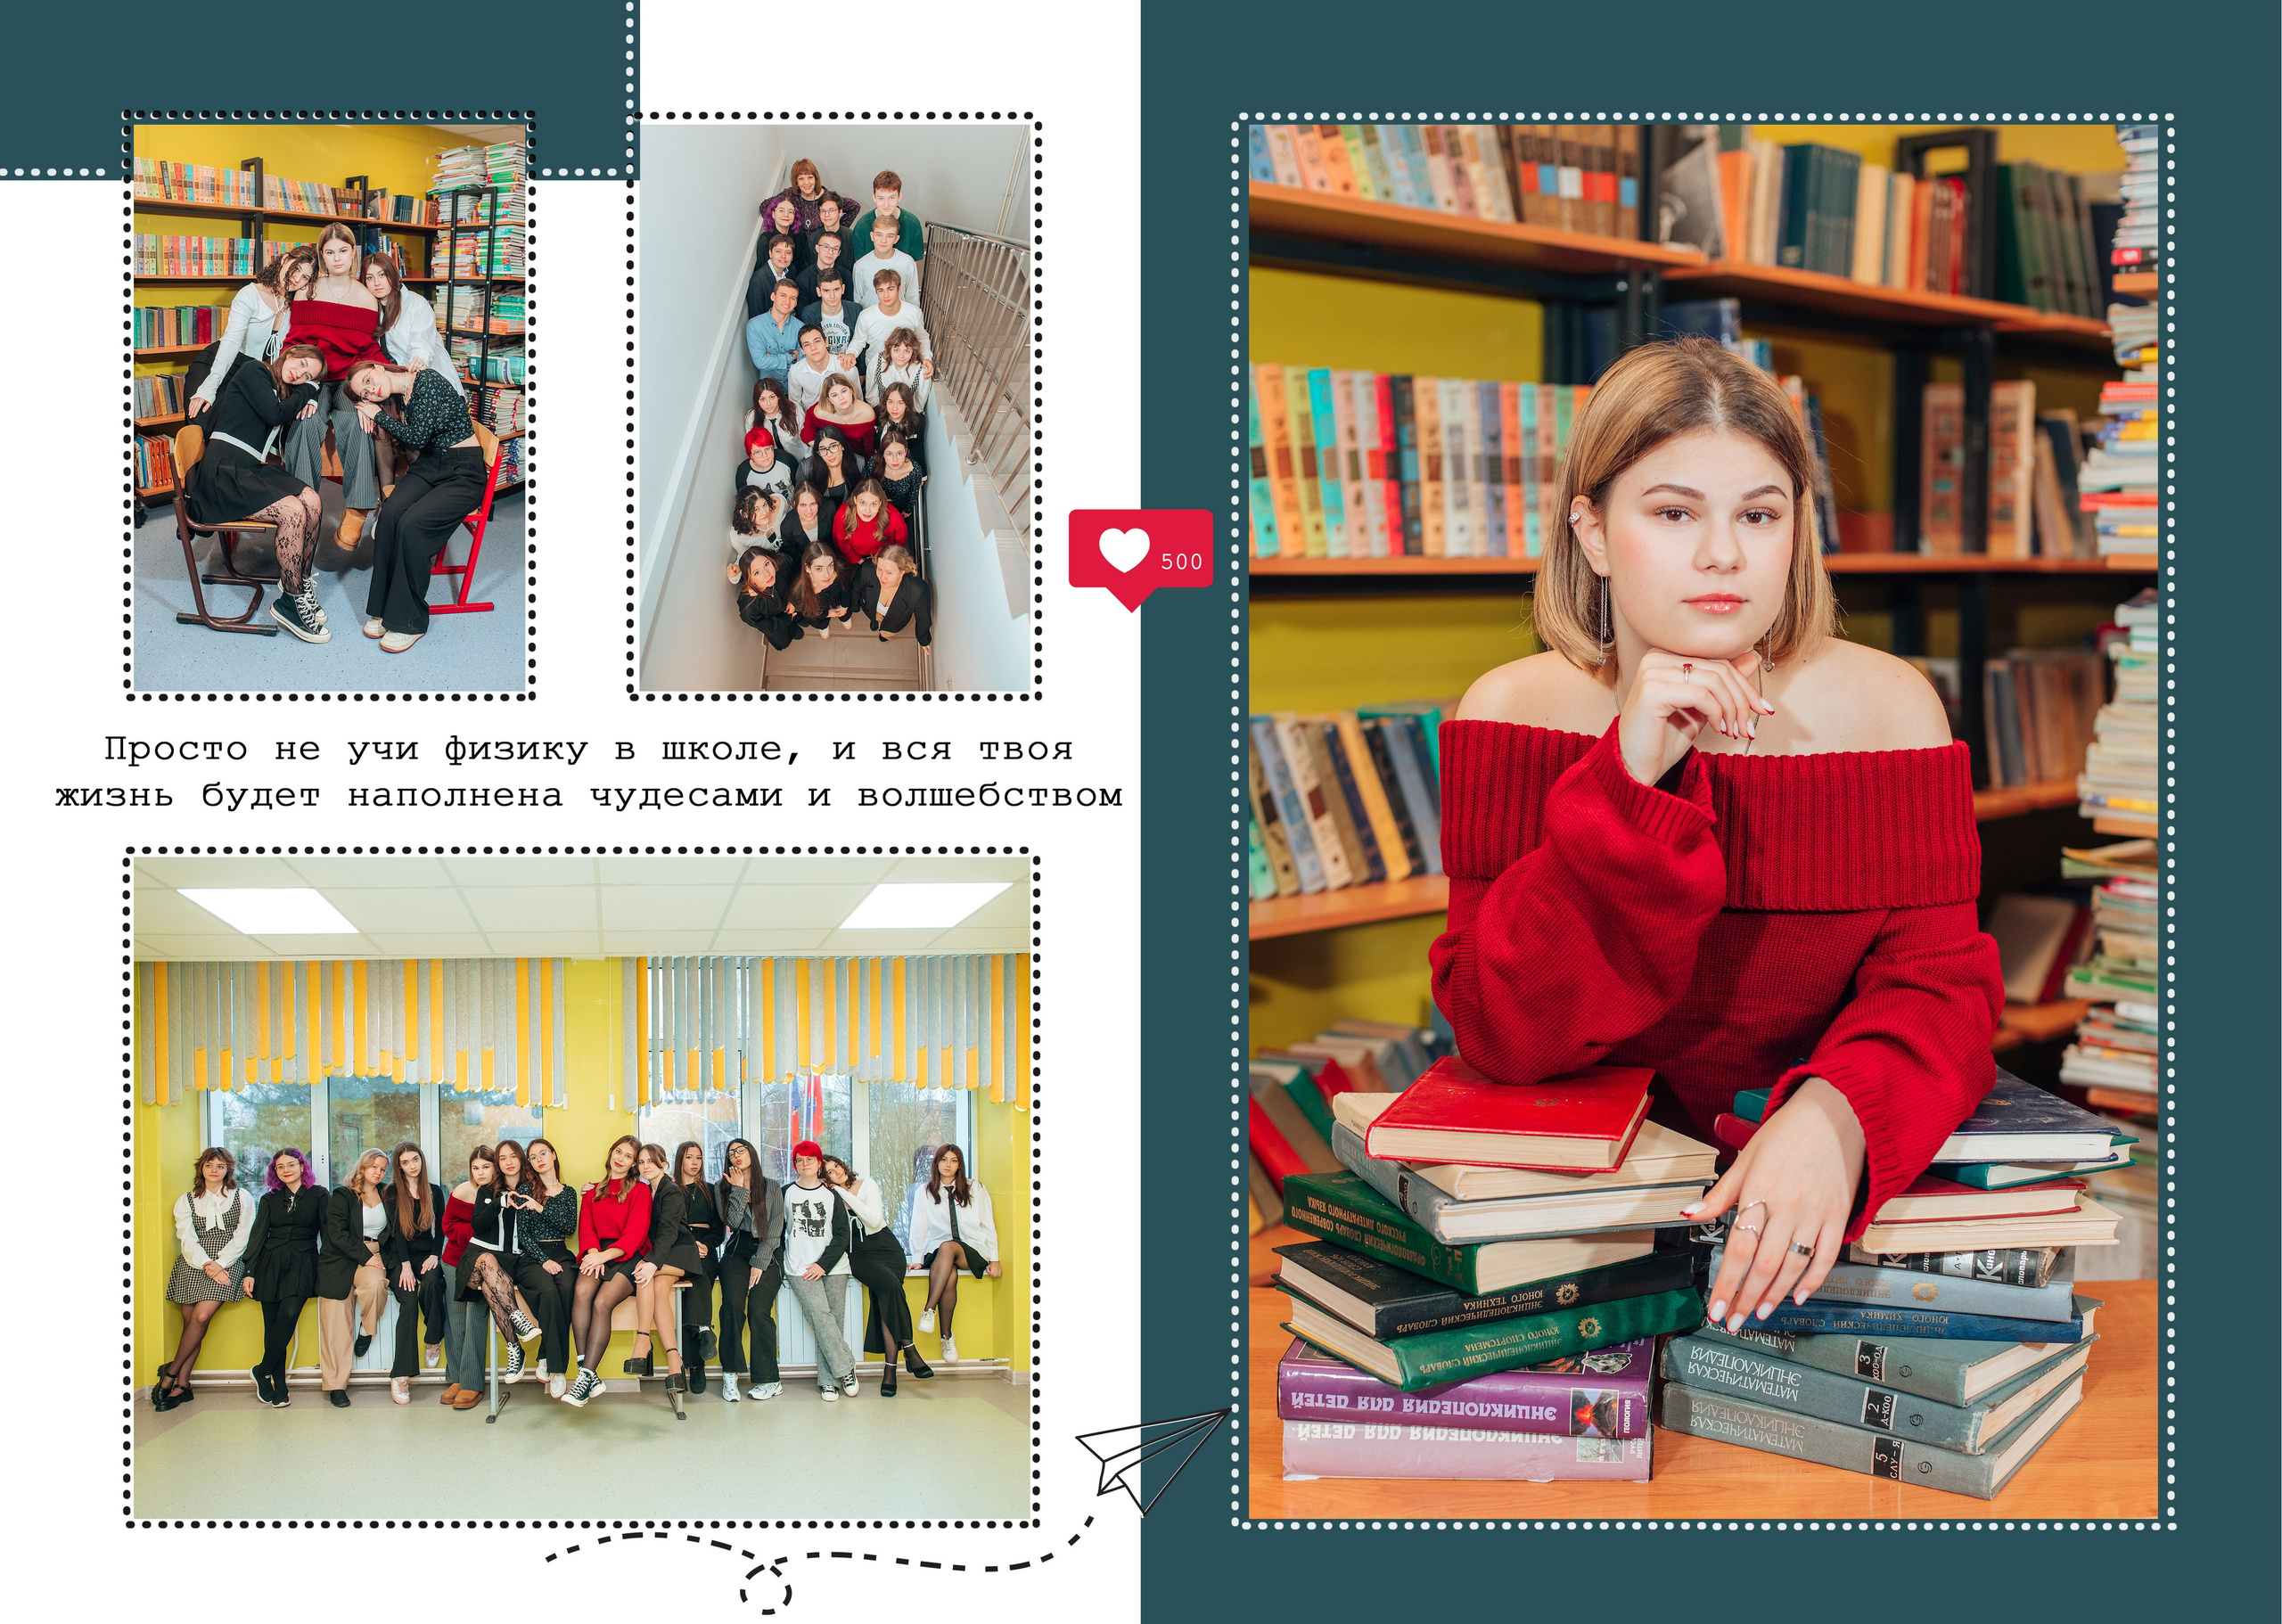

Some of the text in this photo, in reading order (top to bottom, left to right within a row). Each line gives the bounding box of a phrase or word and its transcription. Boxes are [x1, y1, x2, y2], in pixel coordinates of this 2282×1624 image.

[1307, 1195, 1407, 1243] РУССКОГО ЛИТЕРАТУРНОГО ЯЗЫКА
[1291, 1205, 1426, 1267] ФРАЗЕОЛОГИЧЕСКИЙ СЛОВАРЬ СОВРЕМЕННОГО
[2018, 1250, 2028, 1284] словарь
[1817, 1284, 1891, 1300] ЭНЦИКЛОПЕДИ
[1855, 1277, 1892, 1289] ЮНОГО
[1463, 1290, 1543, 1310] ЮНОГО ТЕХНИКА
[1396, 1300, 1543, 1333] ЭНЦИКЛОПЕДИЧЕСКИЙ СЛОВАРЬ
[1781, 1316, 1947, 1335] ЭНЦИКЛОПЕДИЧЕСКИЙ СЛОВАРЬ
[1860, 1310, 1949, 1324] ЮНОГО ХИМИКА
[1465, 1327, 1560, 1353] ЮНОГО СПОРТСМЕНА
[1419, 1339, 1562, 1374] ЭНЦИКЛОПЕДИЧЕСКИЙ СЛОВАРЬ
[1690, 1346, 1802, 1387] ЭНЦИКЛОПЕДИЯ
[1859, 1354, 1871, 1365] 3
[1687, 1362, 1799, 1402] МАТЕМАТИЧЕСКАЯ
[1292, 1391, 1557, 1422] ЭНЦИКЛОПЕДИЯ ДЛЯ ДЕТЕЙ
[1623, 1399, 1631, 1433] ГЕОЛОГИЯ
[1691, 1400, 1805, 1439] ЭНЦИКЛОПЕДИЯ
[1867, 1402, 1880, 1414] 2
[1297, 1423, 1356, 1441] ДЕТЕЙ
[1364, 1424, 1401, 1440] ДЛЯ
[1690, 1415, 1803, 1453] МАТЕМАТИЧЕСКАЯ
[1876, 1452, 1889, 1463] 5
